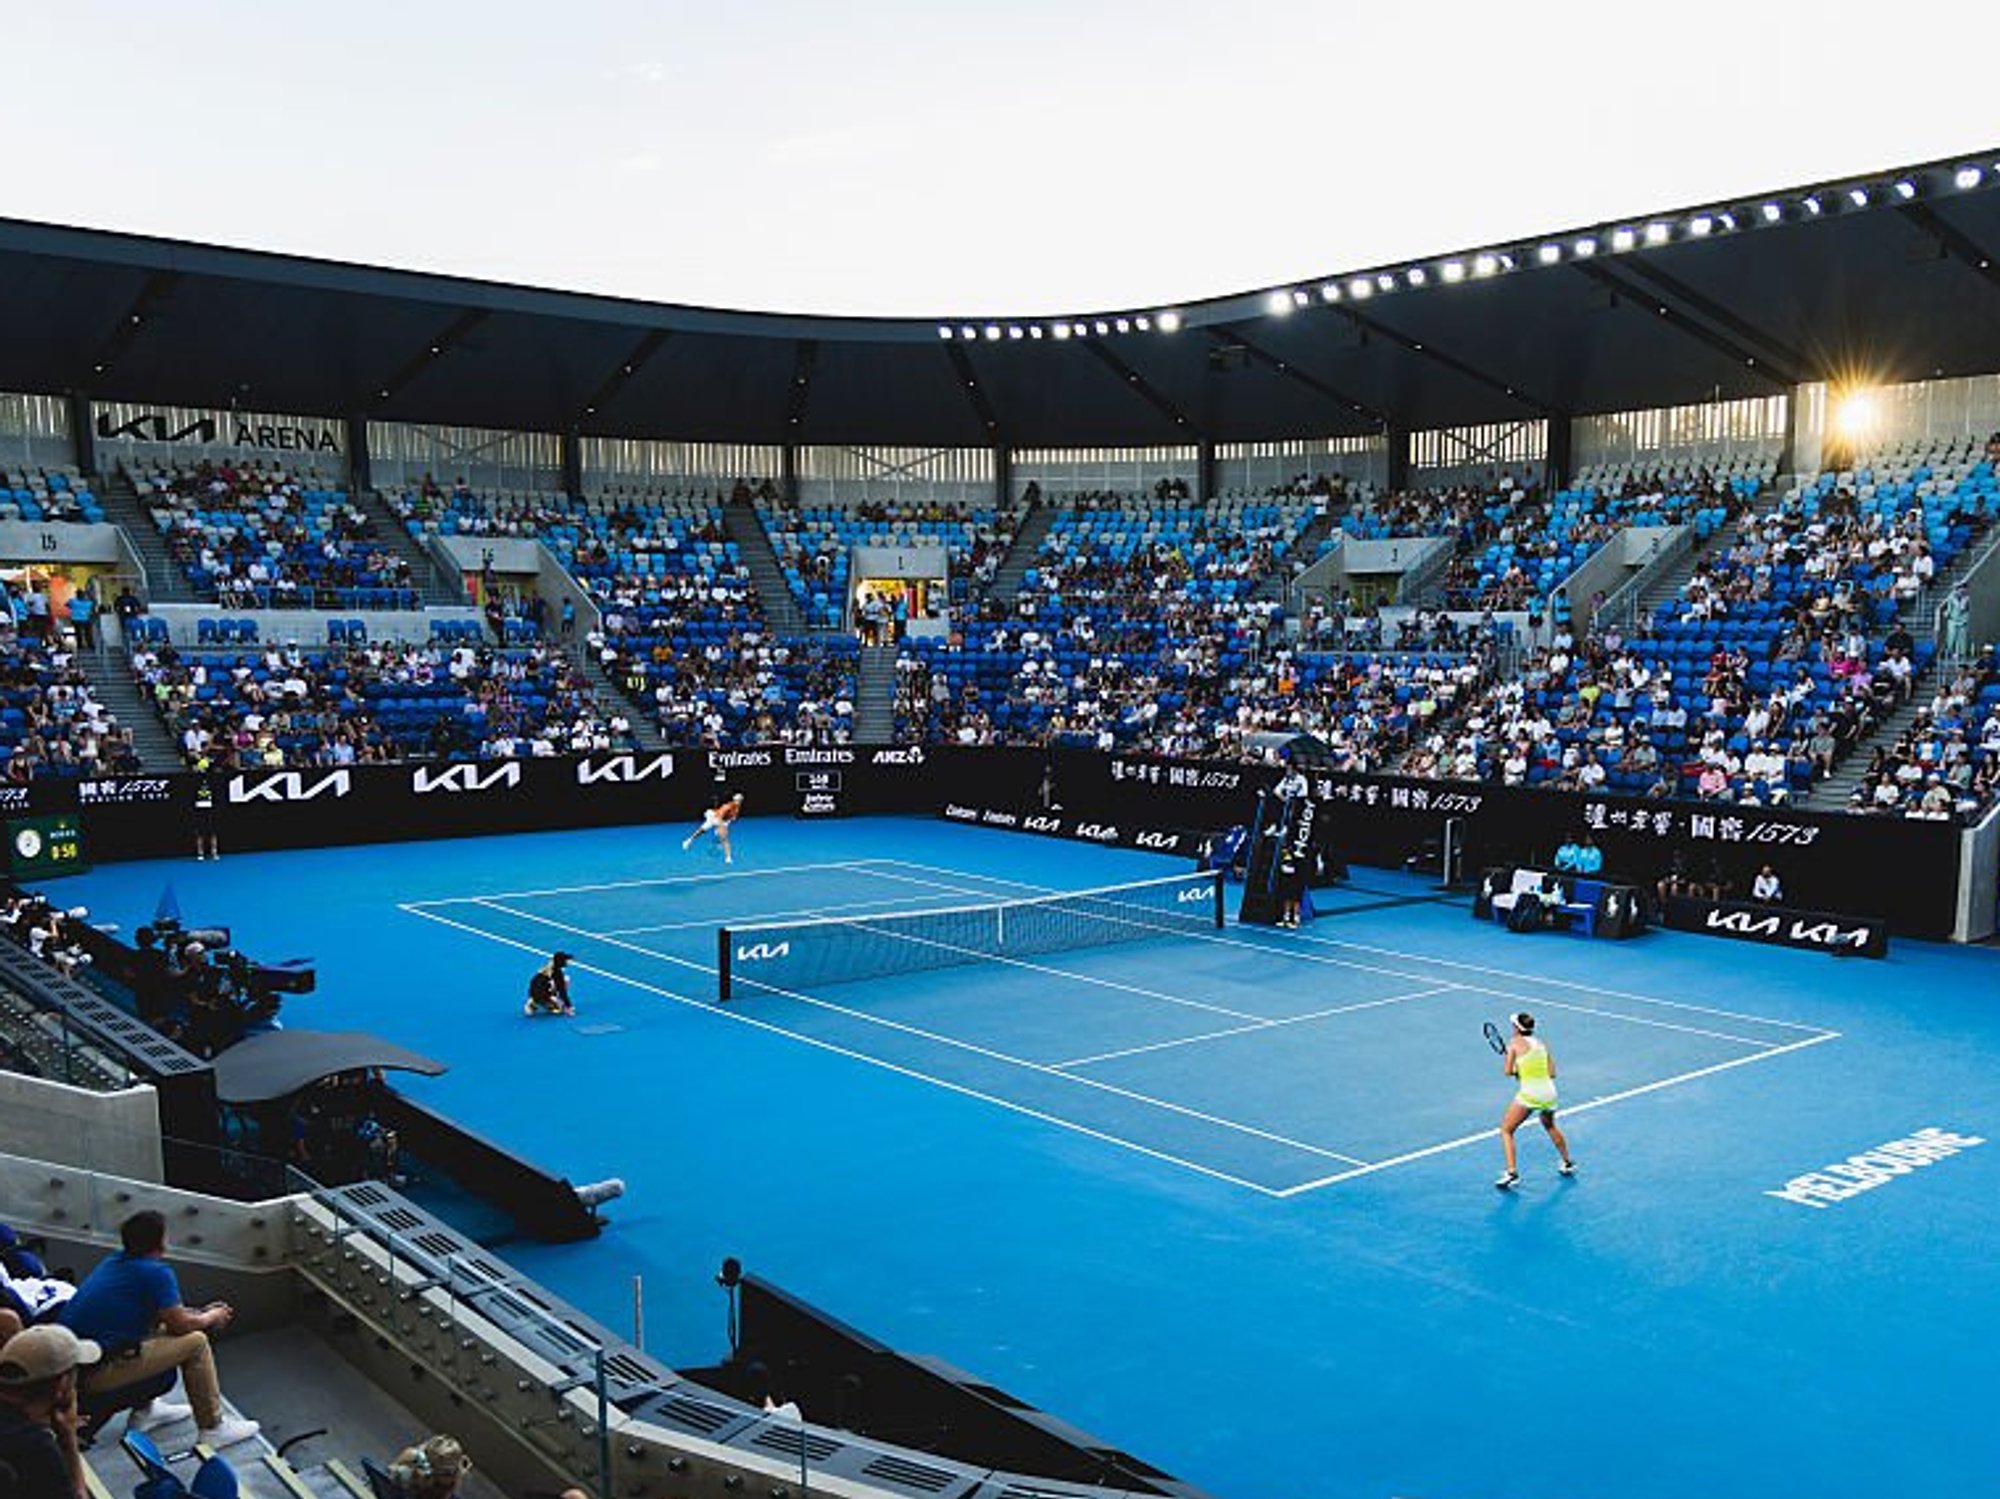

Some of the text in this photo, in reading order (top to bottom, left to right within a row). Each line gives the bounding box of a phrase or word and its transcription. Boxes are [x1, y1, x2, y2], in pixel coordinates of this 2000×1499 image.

[97, 413, 340, 451] KIA ARENA
[42, 534, 57, 551] 15
[578, 754, 674, 784] KIA
[708, 748, 908, 768] Emirates Emirates ANZ
[229, 768, 350, 803] KIA
[413, 761, 521, 792] KIA
[1023, 816, 1061, 832] KIA
[1135, 831, 1179, 848] KIA
[1294, 799, 1316, 858] Haier
[1178, 885, 1215, 902] KIA
[1707, 909, 1869, 947] KIA KIA
[737, 941, 789, 960] KIA
[1762, 1127, 1987, 1208] MELBOURNE
